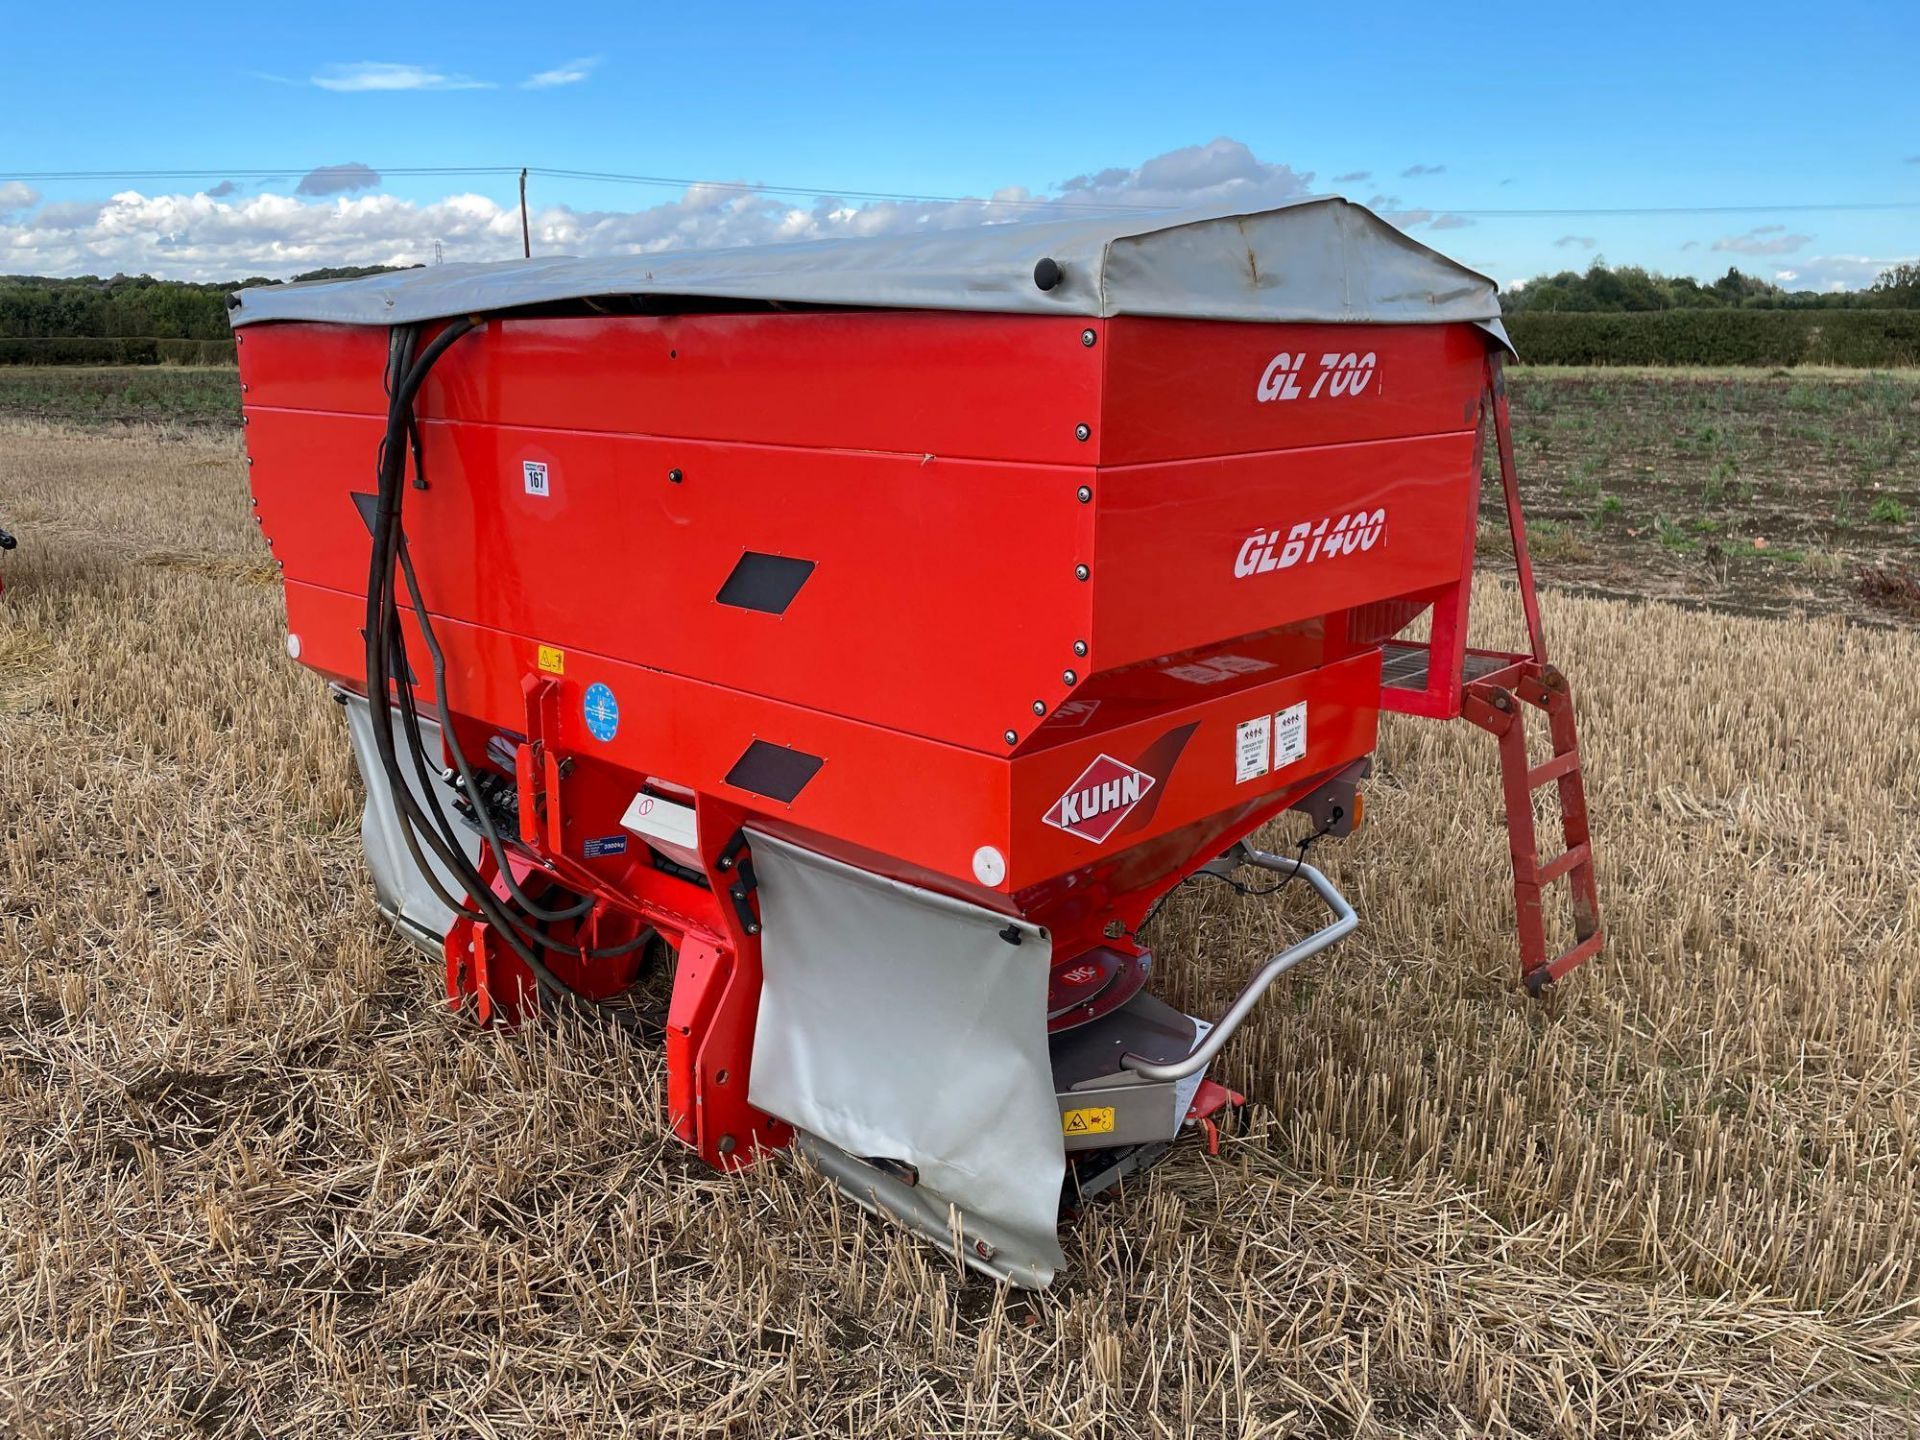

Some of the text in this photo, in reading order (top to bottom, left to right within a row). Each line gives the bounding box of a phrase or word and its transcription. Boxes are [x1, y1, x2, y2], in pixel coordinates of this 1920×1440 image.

[1257, 352, 1376, 403] GL 700
[528, 471, 543, 489] 167
[1061, 772, 1140, 828] KUHN
